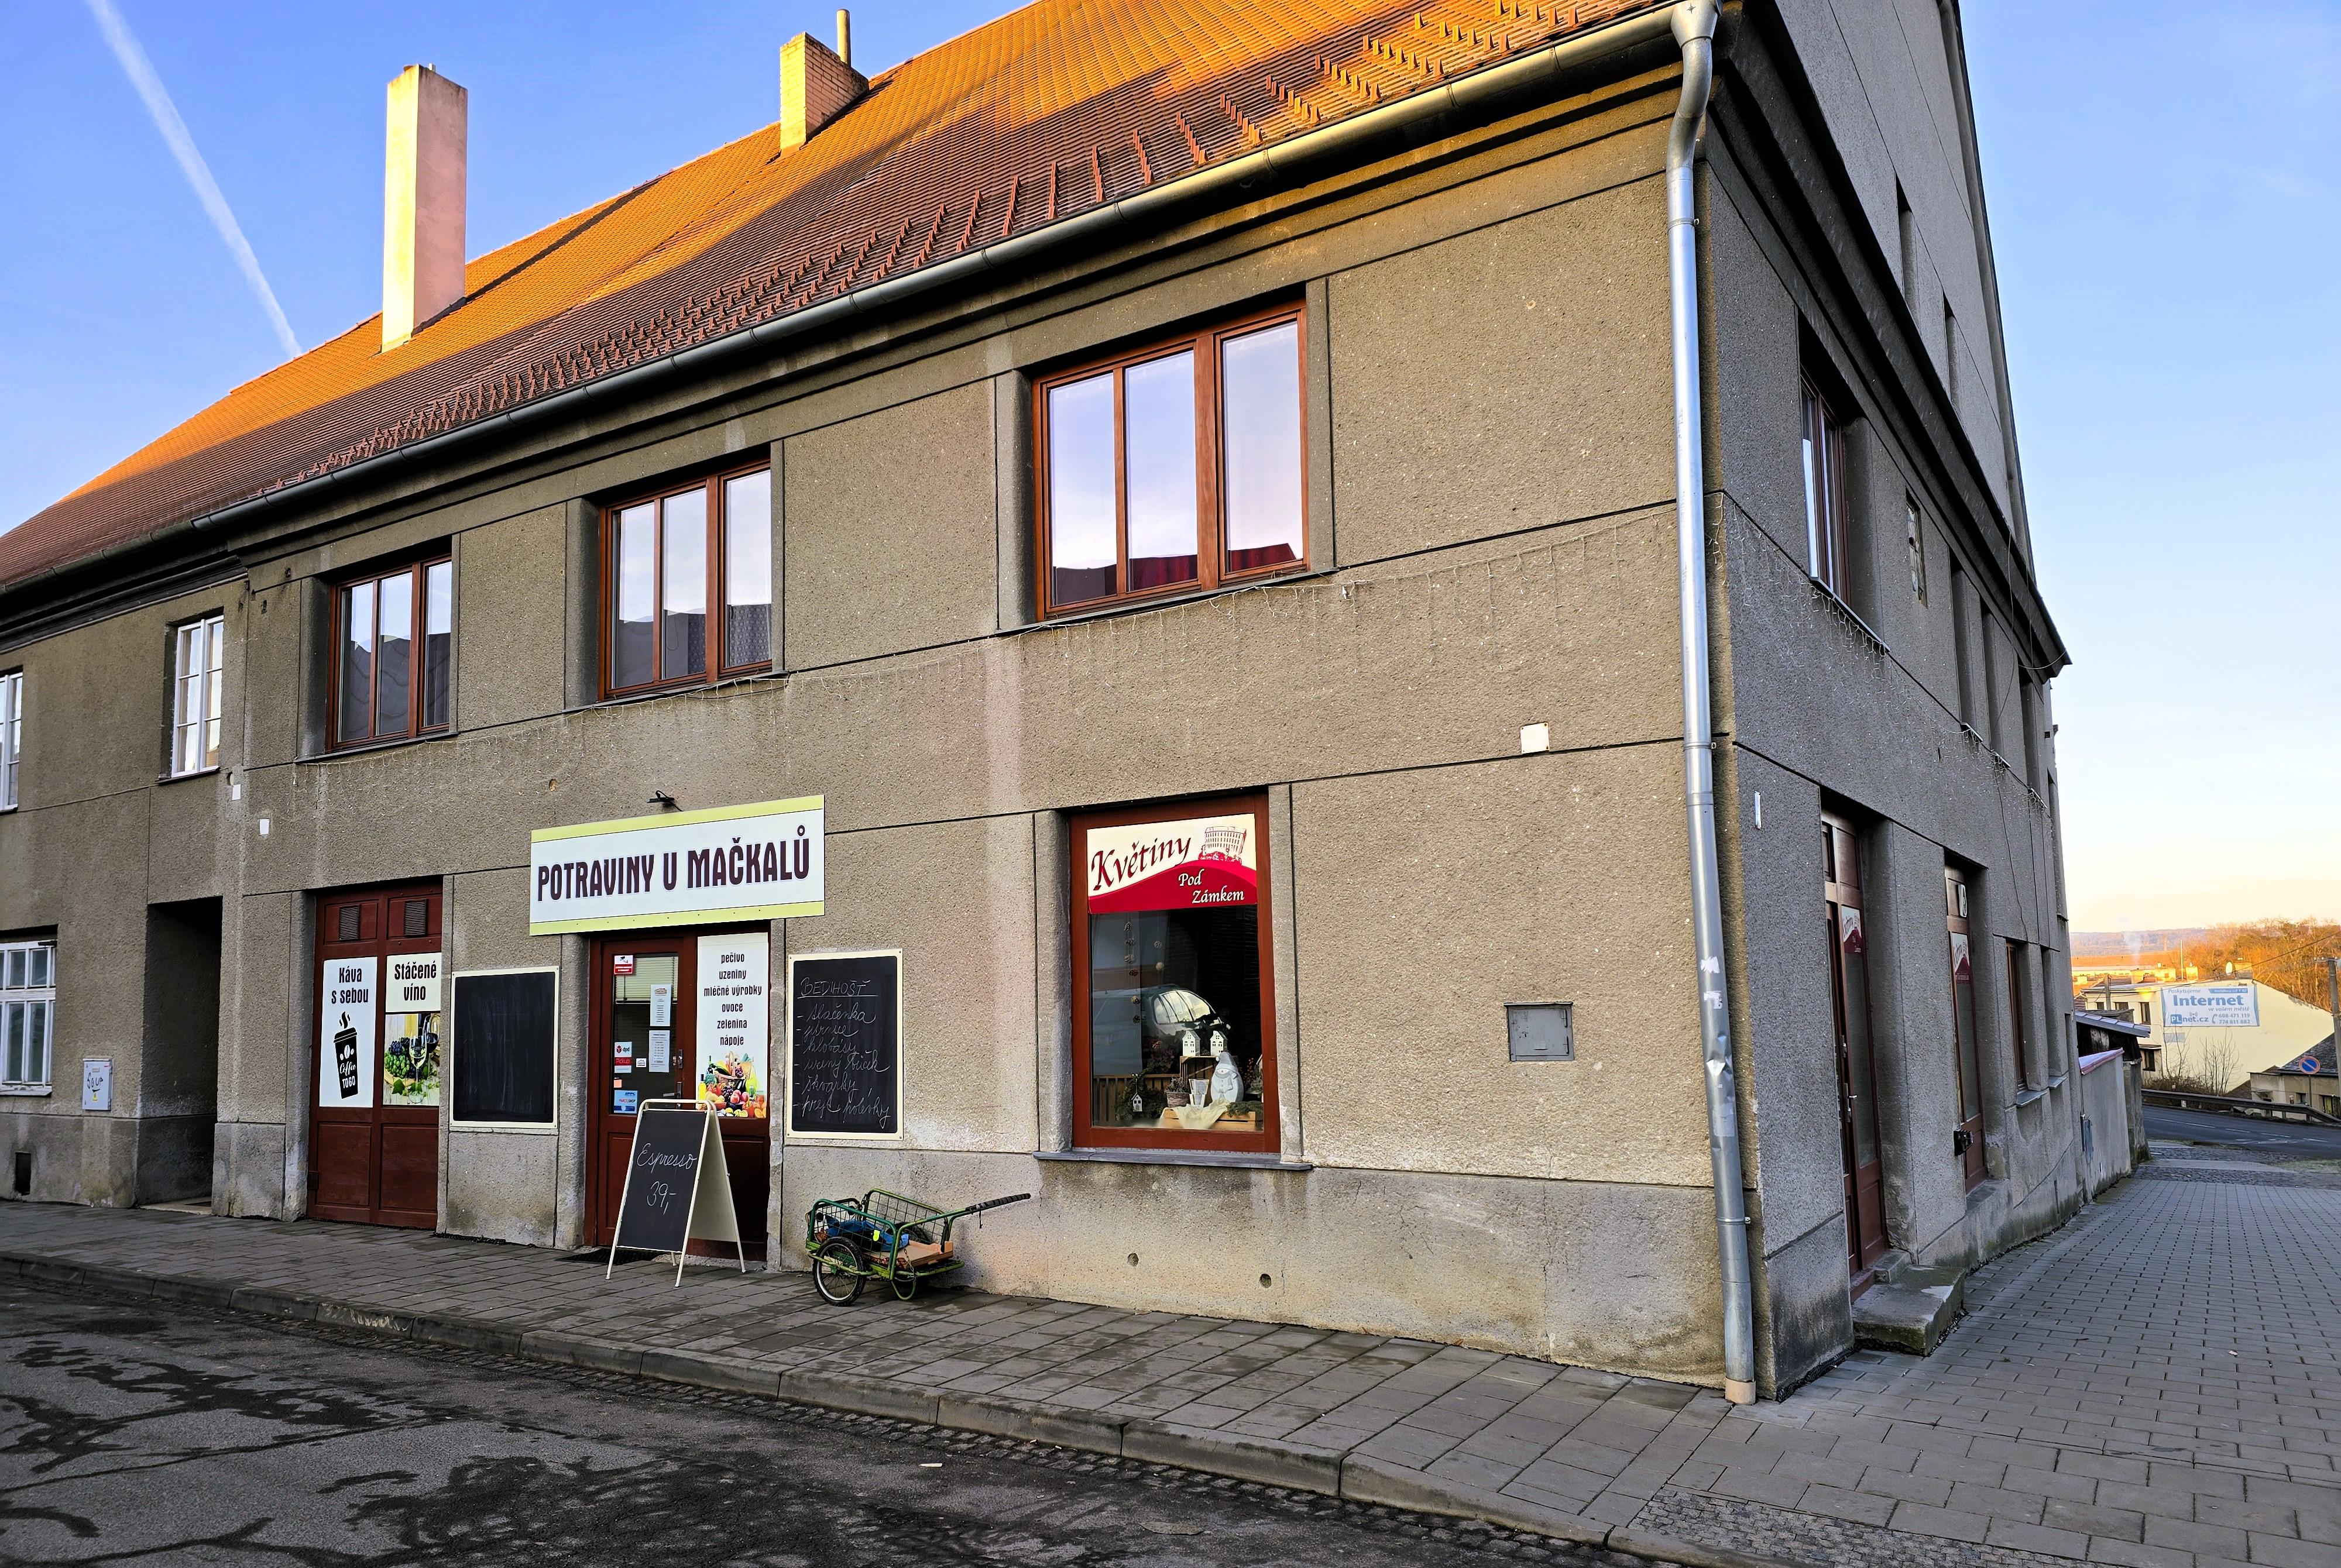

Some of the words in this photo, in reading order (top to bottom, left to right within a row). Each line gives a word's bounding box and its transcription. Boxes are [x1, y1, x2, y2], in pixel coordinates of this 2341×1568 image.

[538, 854, 654, 902] POTRAVINY
[663, 851, 677, 890] U
[687, 824, 809, 889] MAČKALŮ
[1091, 837, 1192, 890] Květiny
[1178, 868, 1204, 886] Pod
[1192, 885, 1244, 903] Zámkem
[721, 953, 744, 964] pečivo
[339, 966, 362, 983] Káva
[394, 961, 437, 980] Stáčené
[719, 969, 746, 979] uzeniny
[404, 984, 426, 1001] víno
[704, 985, 729, 996] mléčné
[732, 984, 761, 996] výrobky
[801, 976, 871, 996] BEDIHOŠŤ
[331, 990, 337, 1004] s
[340, 988, 369, 1003] sebou
[2173, 995, 2244, 1006] Internet
[722, 1003, 743, 1012] ovoce
[717, 1019, 747, 1029] zelenina
[720, 1035, 744, 1046] nápoje
[339, 1061, 356, 1076] Coffee
[637, 1143, 697, 1174] Espresso
